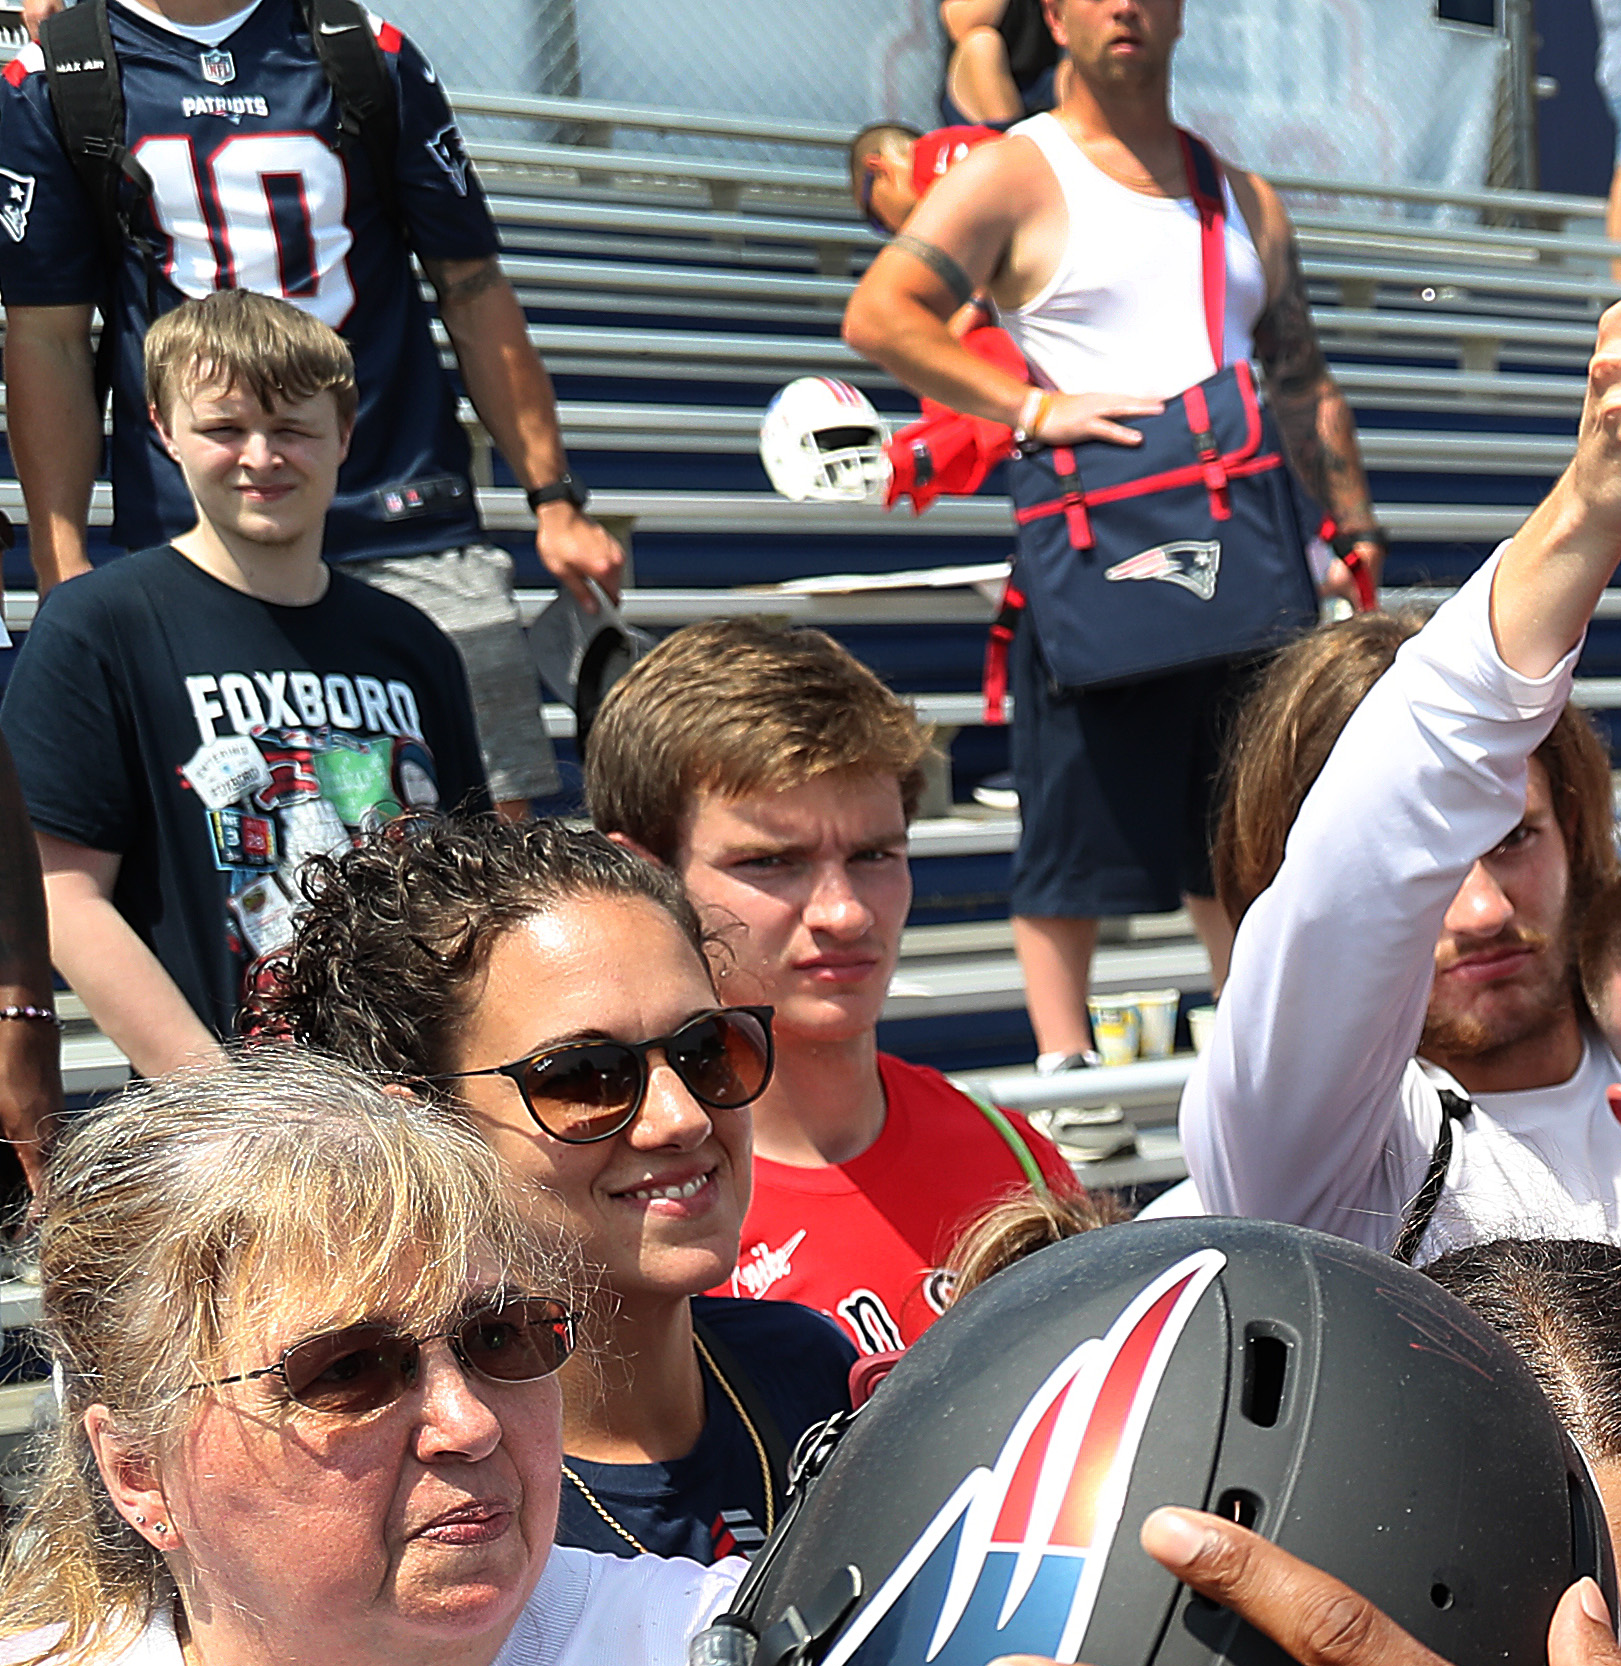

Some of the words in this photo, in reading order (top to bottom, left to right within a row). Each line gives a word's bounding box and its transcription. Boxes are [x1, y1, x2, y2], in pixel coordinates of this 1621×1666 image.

[56, 62, 81, 73] MAX
[83, 58, 105, 71] AIR
[182, 95, 269, 117] PATRIOTS
[129, 130, 357, 334] 10
[185, 671, 424, 746] FOXBORO
